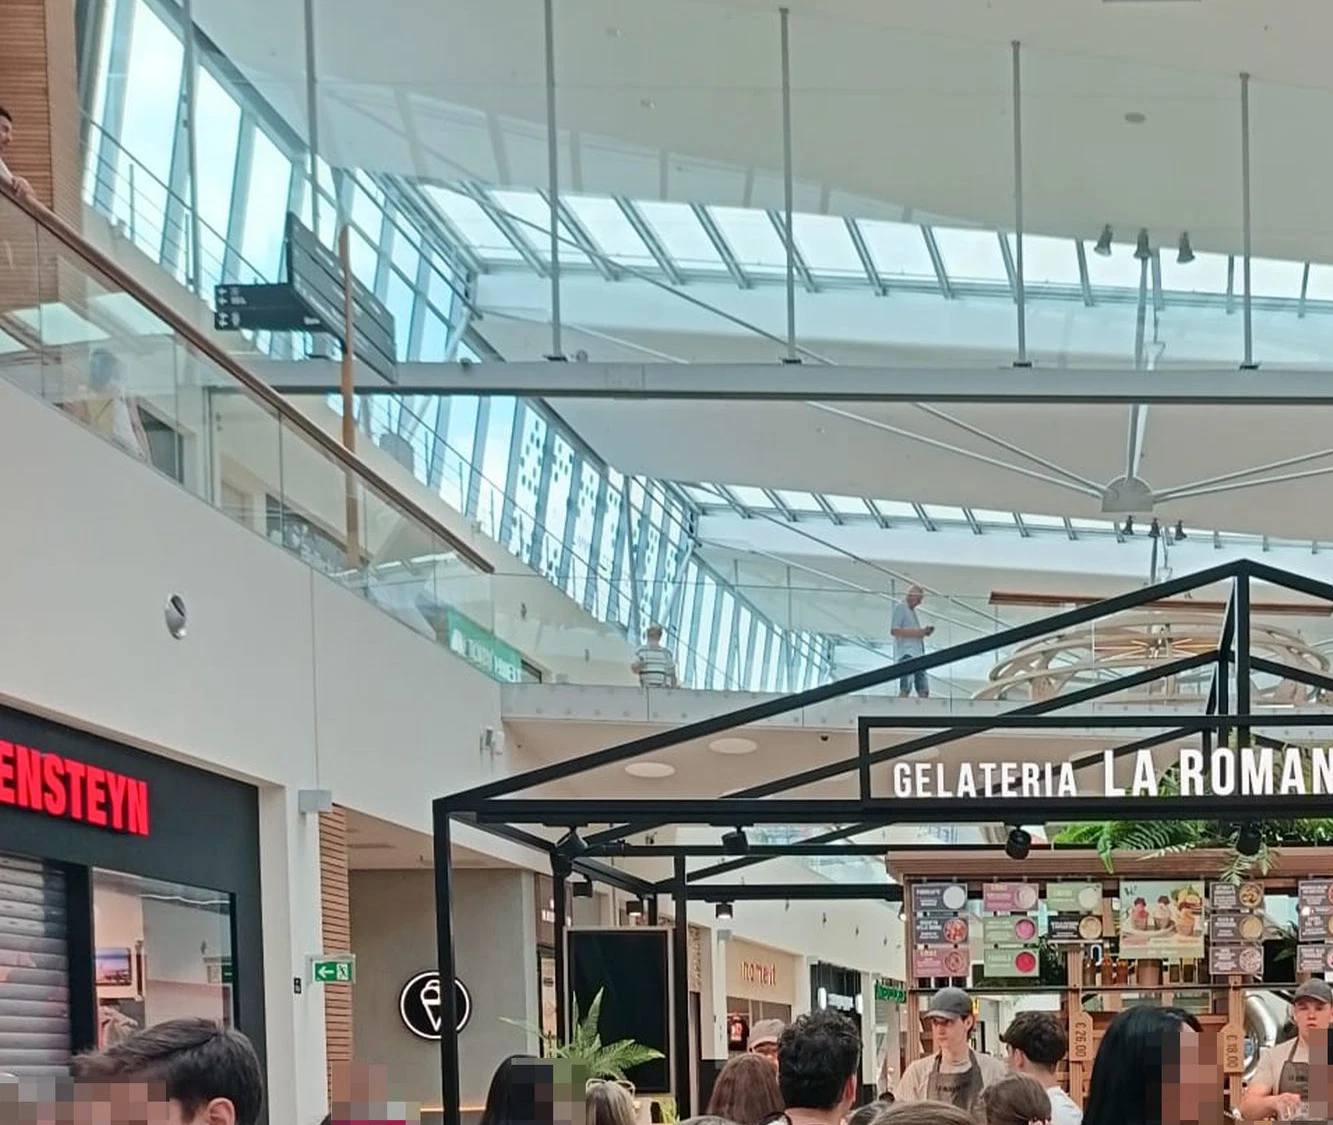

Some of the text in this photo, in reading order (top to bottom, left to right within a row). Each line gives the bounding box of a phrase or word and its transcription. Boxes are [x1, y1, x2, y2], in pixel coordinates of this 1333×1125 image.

[0, 739, 149, 837] ENSTEYN
[893, 761, 1077, 798] GELATERIA
[1104, 748, 1159, 797] LA
